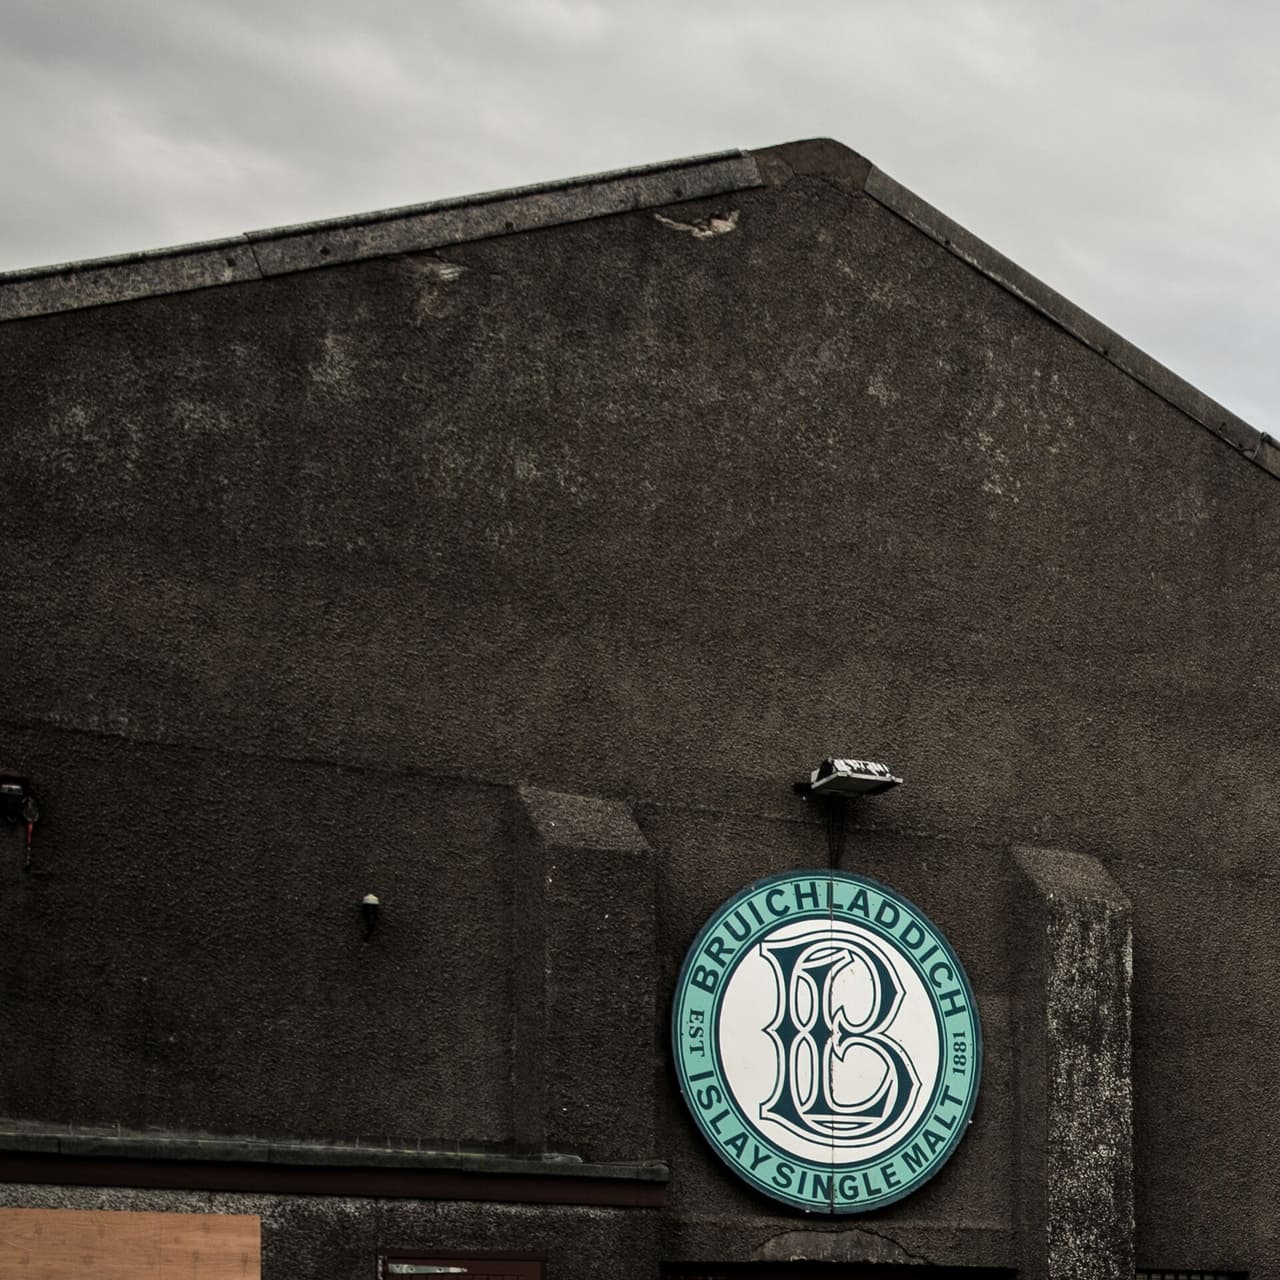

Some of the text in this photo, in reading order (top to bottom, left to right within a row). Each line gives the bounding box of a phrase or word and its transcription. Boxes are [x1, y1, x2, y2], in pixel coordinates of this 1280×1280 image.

[691, 881, 967, 1018] BRUICHLADDICH
[689, 1008, 705, 1057] EST
[952, 1031, 967, 1076] 1881
[689, 1071, 964, 1200] ISLAY SINGLE MALT
